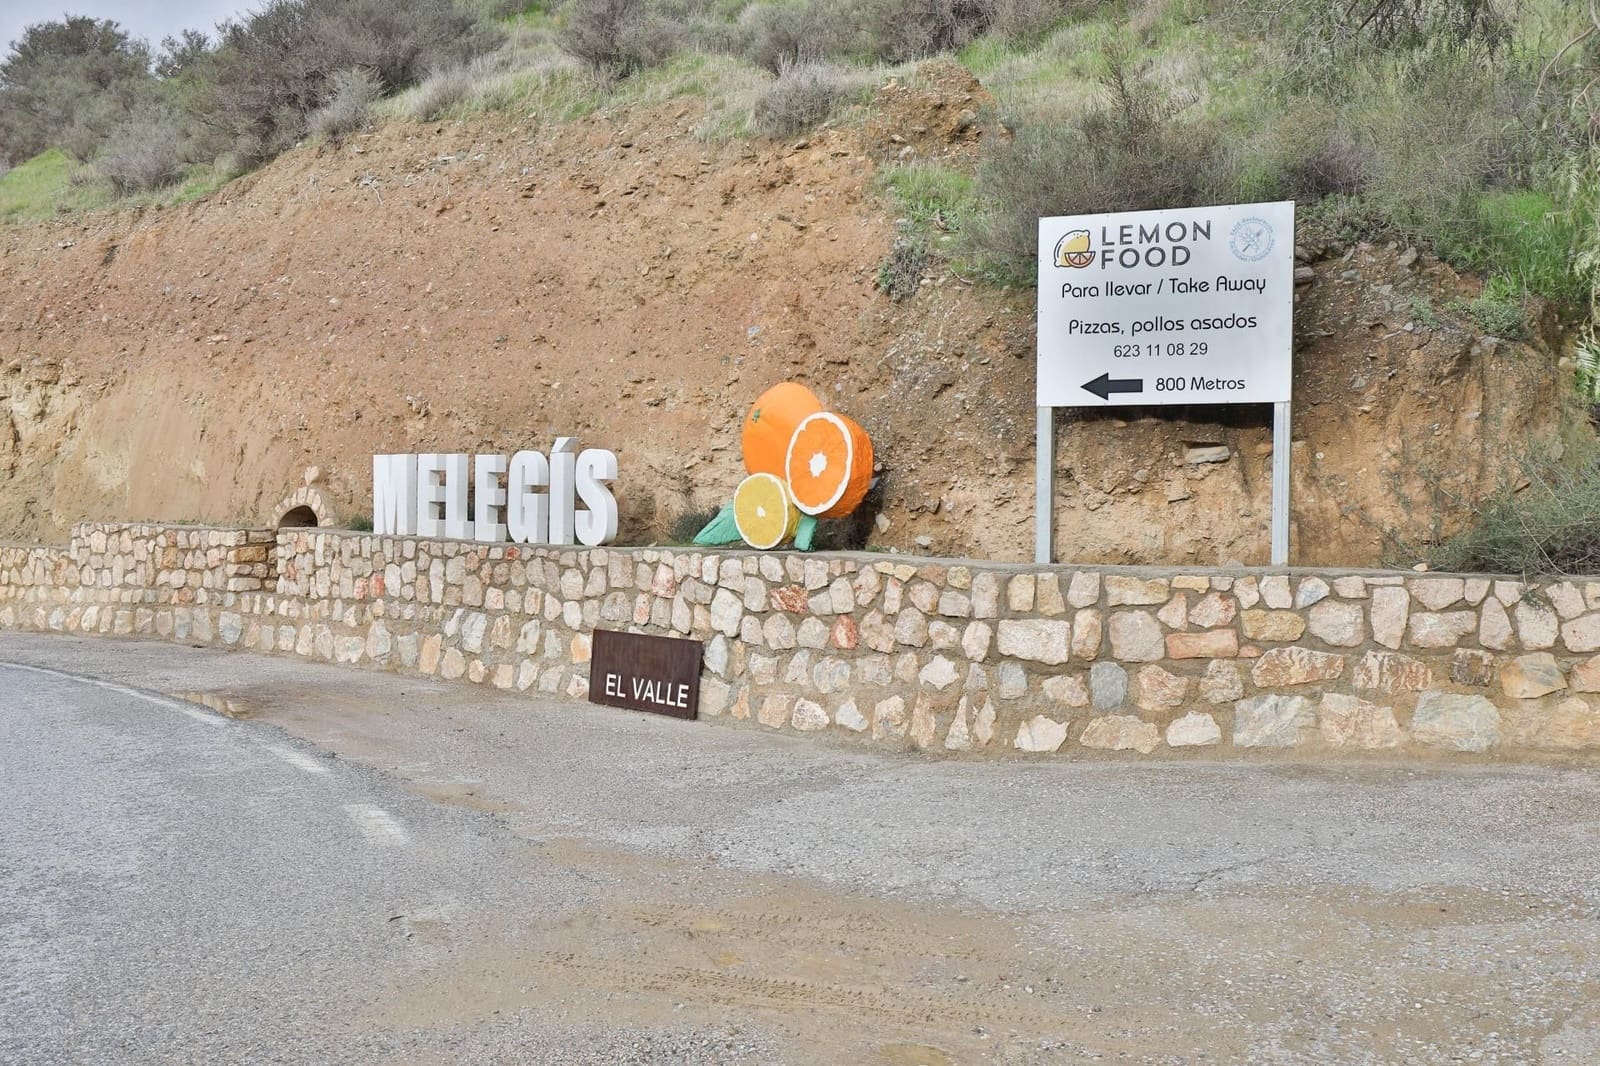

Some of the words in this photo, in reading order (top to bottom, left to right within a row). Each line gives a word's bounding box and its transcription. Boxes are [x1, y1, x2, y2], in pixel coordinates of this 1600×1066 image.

[1102, 220, 1211, 246] LEMON
[1101, 245, 1191, 269] FOOD
[1062, 283, 1099, 298] Para
[1105, 281, 1152, 296] llevar
[1157, 279, 1164, 295] /
[1169, 277, 1210, 294] Take
[1216, 276, 1266, 294] Away
[1069, 319, 1124, 335] Pizzas,
[1132, 316, 1184, 336] pollos
[1191, 313, 1257, 331] asados
[1114, 345, 1141, 358] 623
[1146, 344, 1160, 357] 11
[1167, 343, 1185, 356] 08
[1190, 342, 1208, 356] 29
[1155, 377, 1186, 391] 800
[1191, 376, 1246, 391] Metros
[373, 436, 618, 546] MELEGÍS
[605, 673, 626, 698] EL
[632, 677, 689, 708] VALLE
